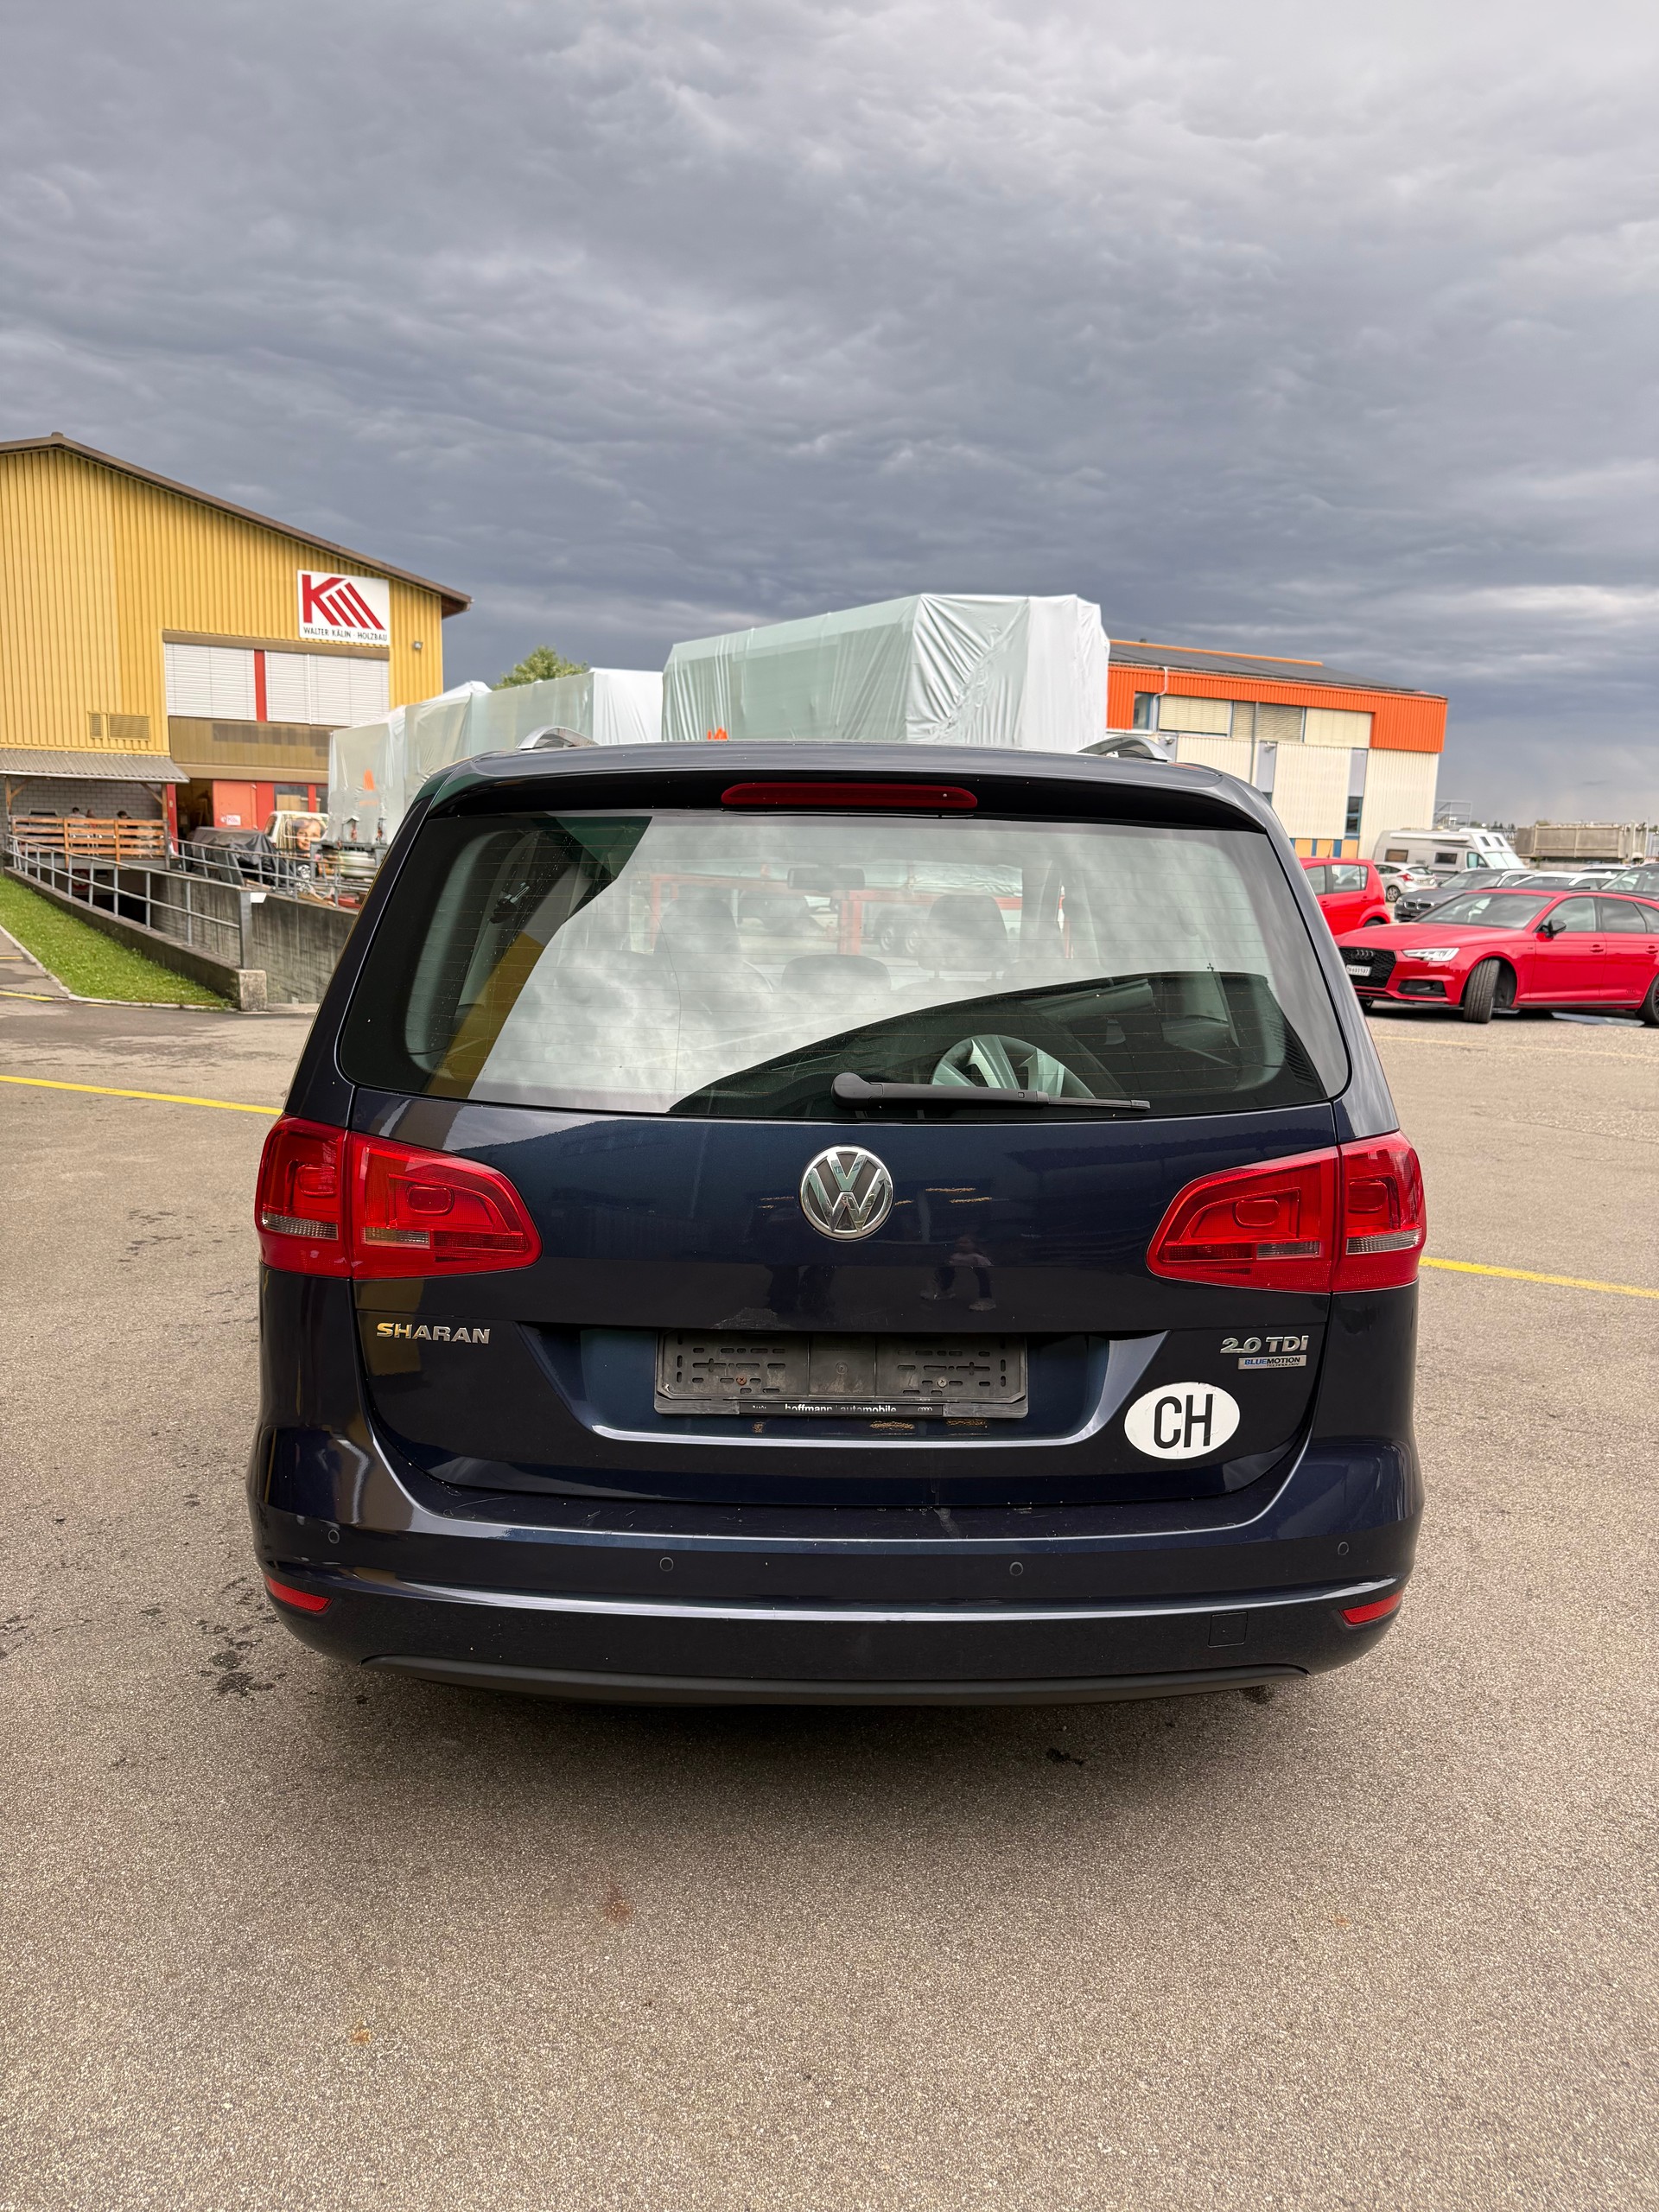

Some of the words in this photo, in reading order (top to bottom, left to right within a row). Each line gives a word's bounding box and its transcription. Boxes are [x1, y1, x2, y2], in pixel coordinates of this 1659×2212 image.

[303, 626, 329, 637] WALTER
[331, 628, 352, 639] KÄLIN
[357, 632, 388, 641] HOLZBAU
[804, 1148, 891, 1236] VW
[376, 1322, 491, 1344] SHARAN
[1244, 1357, 1301, 1365] BLUEMOTION
[1154, 1393, 1214, 1449] CH
